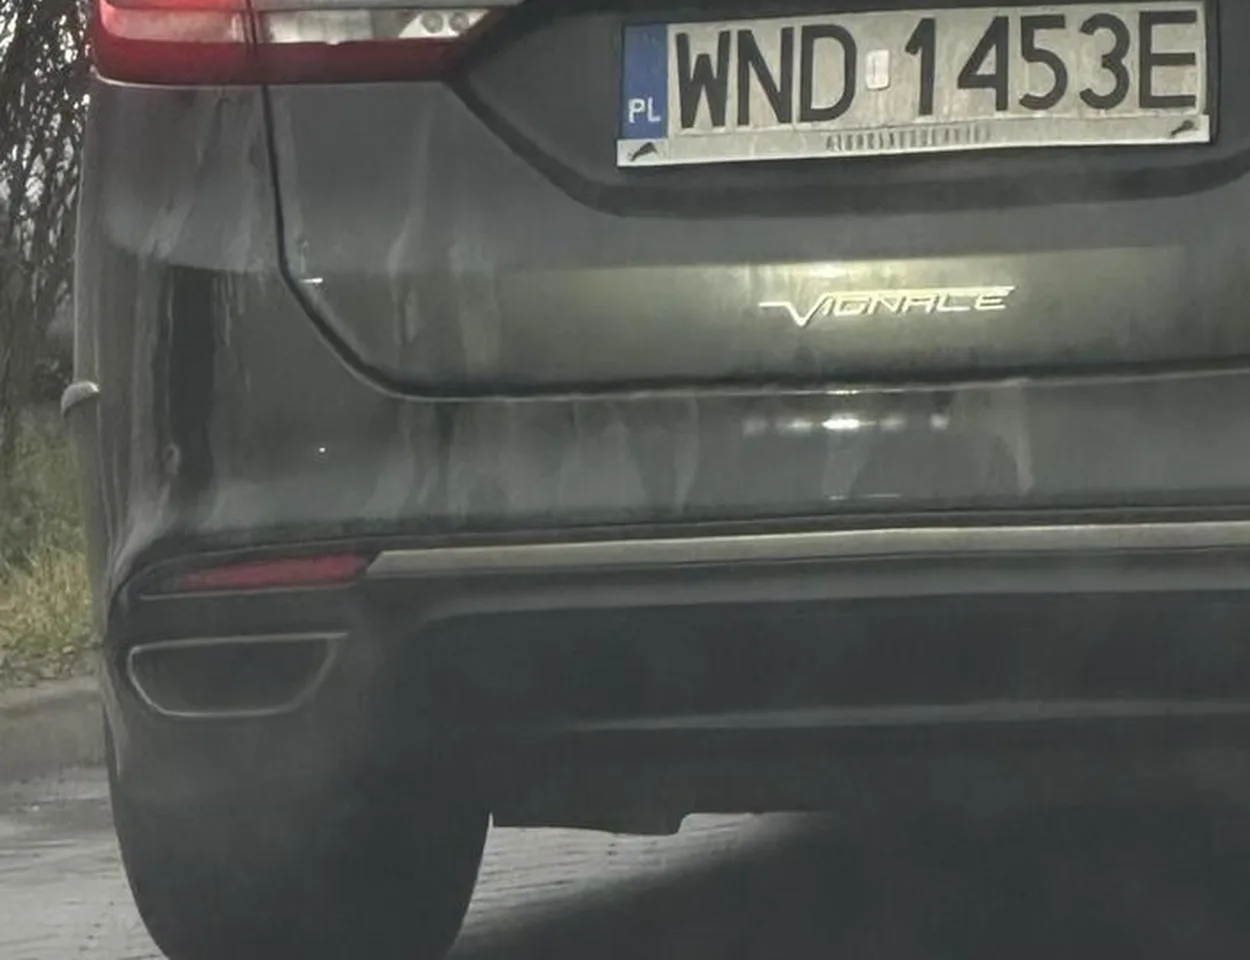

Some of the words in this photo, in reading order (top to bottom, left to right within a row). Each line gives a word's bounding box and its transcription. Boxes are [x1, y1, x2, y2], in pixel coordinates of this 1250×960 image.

[675, 23, 857, 130] WND
[904, 9, 1198, 117] 1453E
[628, 99, 662, 124] PL
